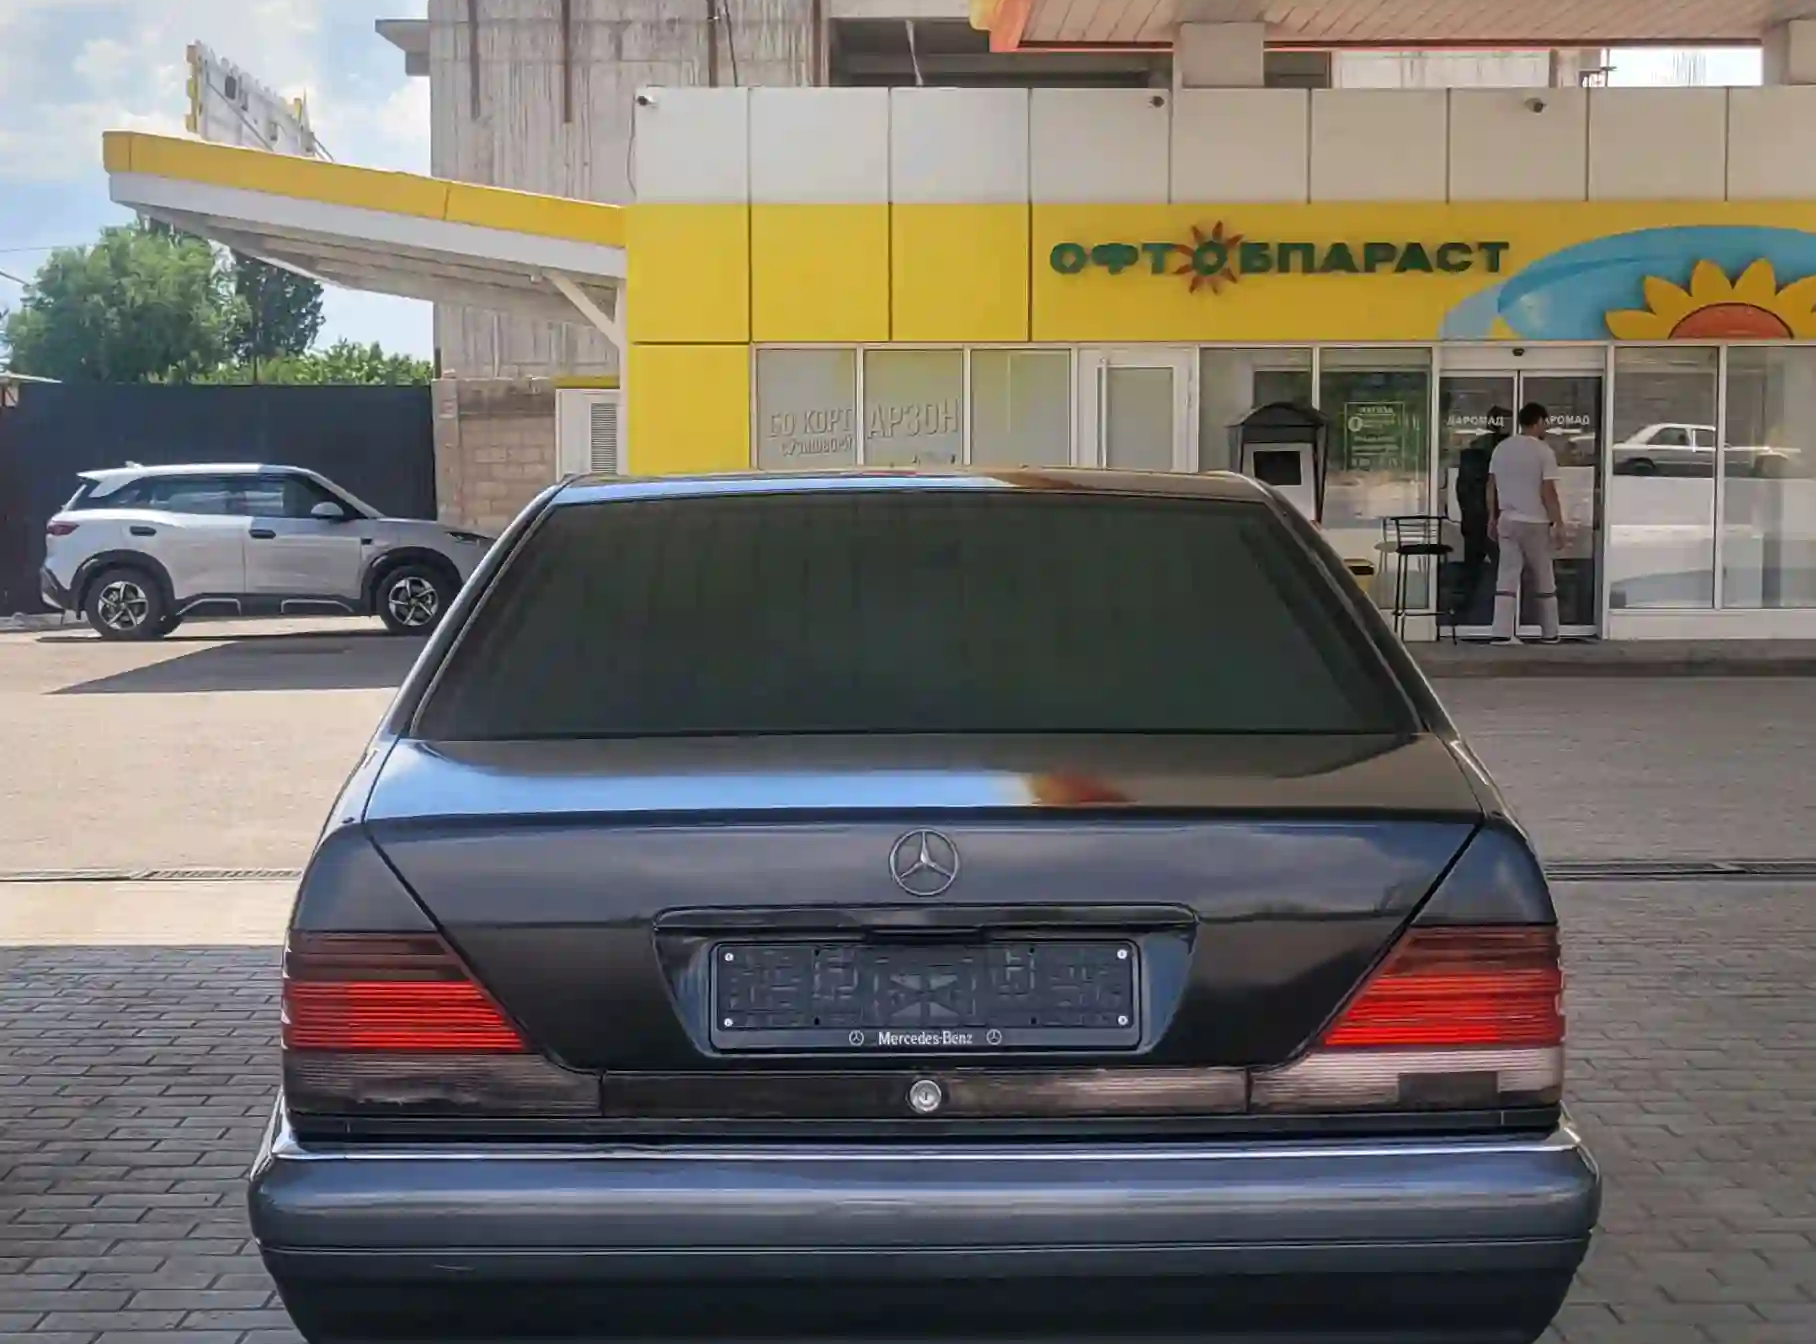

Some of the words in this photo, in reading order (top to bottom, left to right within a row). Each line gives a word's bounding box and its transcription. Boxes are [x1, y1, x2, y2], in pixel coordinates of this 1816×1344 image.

[1049, 240, 1510, 276] ОФТОБПАРАСТ
[867, 398, 960, 440] АРЗОН
[878, 1030, 974, 1046] Mercedes-Benz
